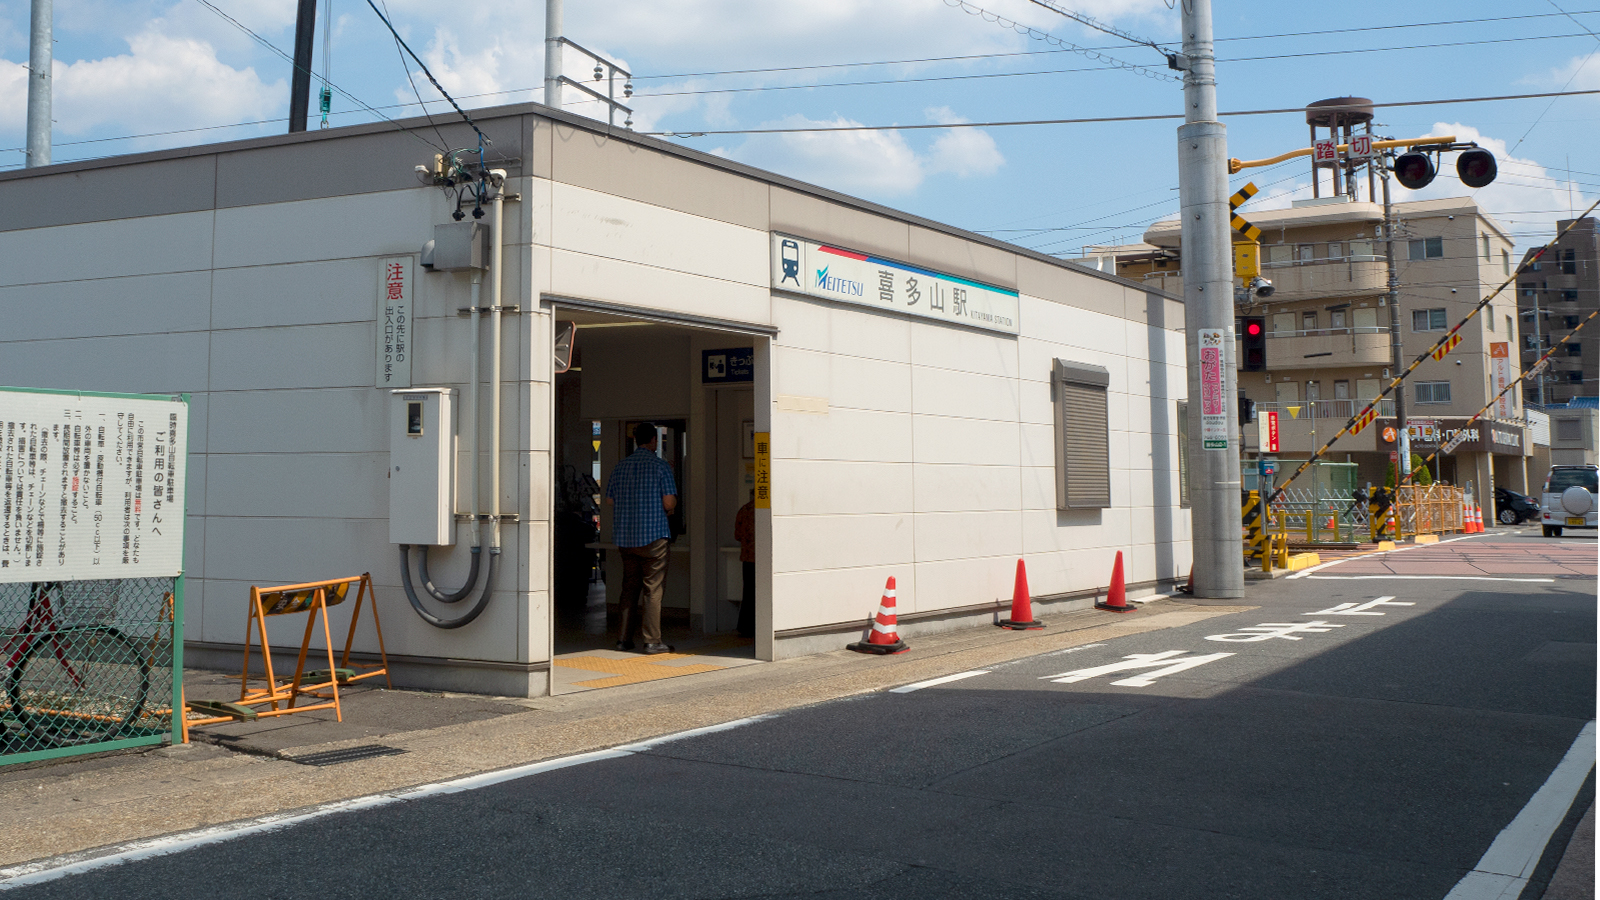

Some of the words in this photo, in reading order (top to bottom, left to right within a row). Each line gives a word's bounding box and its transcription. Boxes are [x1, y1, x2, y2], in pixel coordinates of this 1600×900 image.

[1316, 136, 1371, 160] 踏切
[386, 262, 404, 300] 注意
[815, 264, 864, 297] MEITETSU
[878, 269, 968, 317] 喜多山駅
[384, 305, 394, 383] 出入口があります
[395, 305, 406, 363] この先に駅の
[994, 315, 1013, 327] STATION
[1203, 350, 1218, 381] おがた
[152, 431, 166, 536] ご利用の皆さんへ
[757, 441, 769, 500] 車に注意
[1037, 595, 1417, 688] 止まれ
